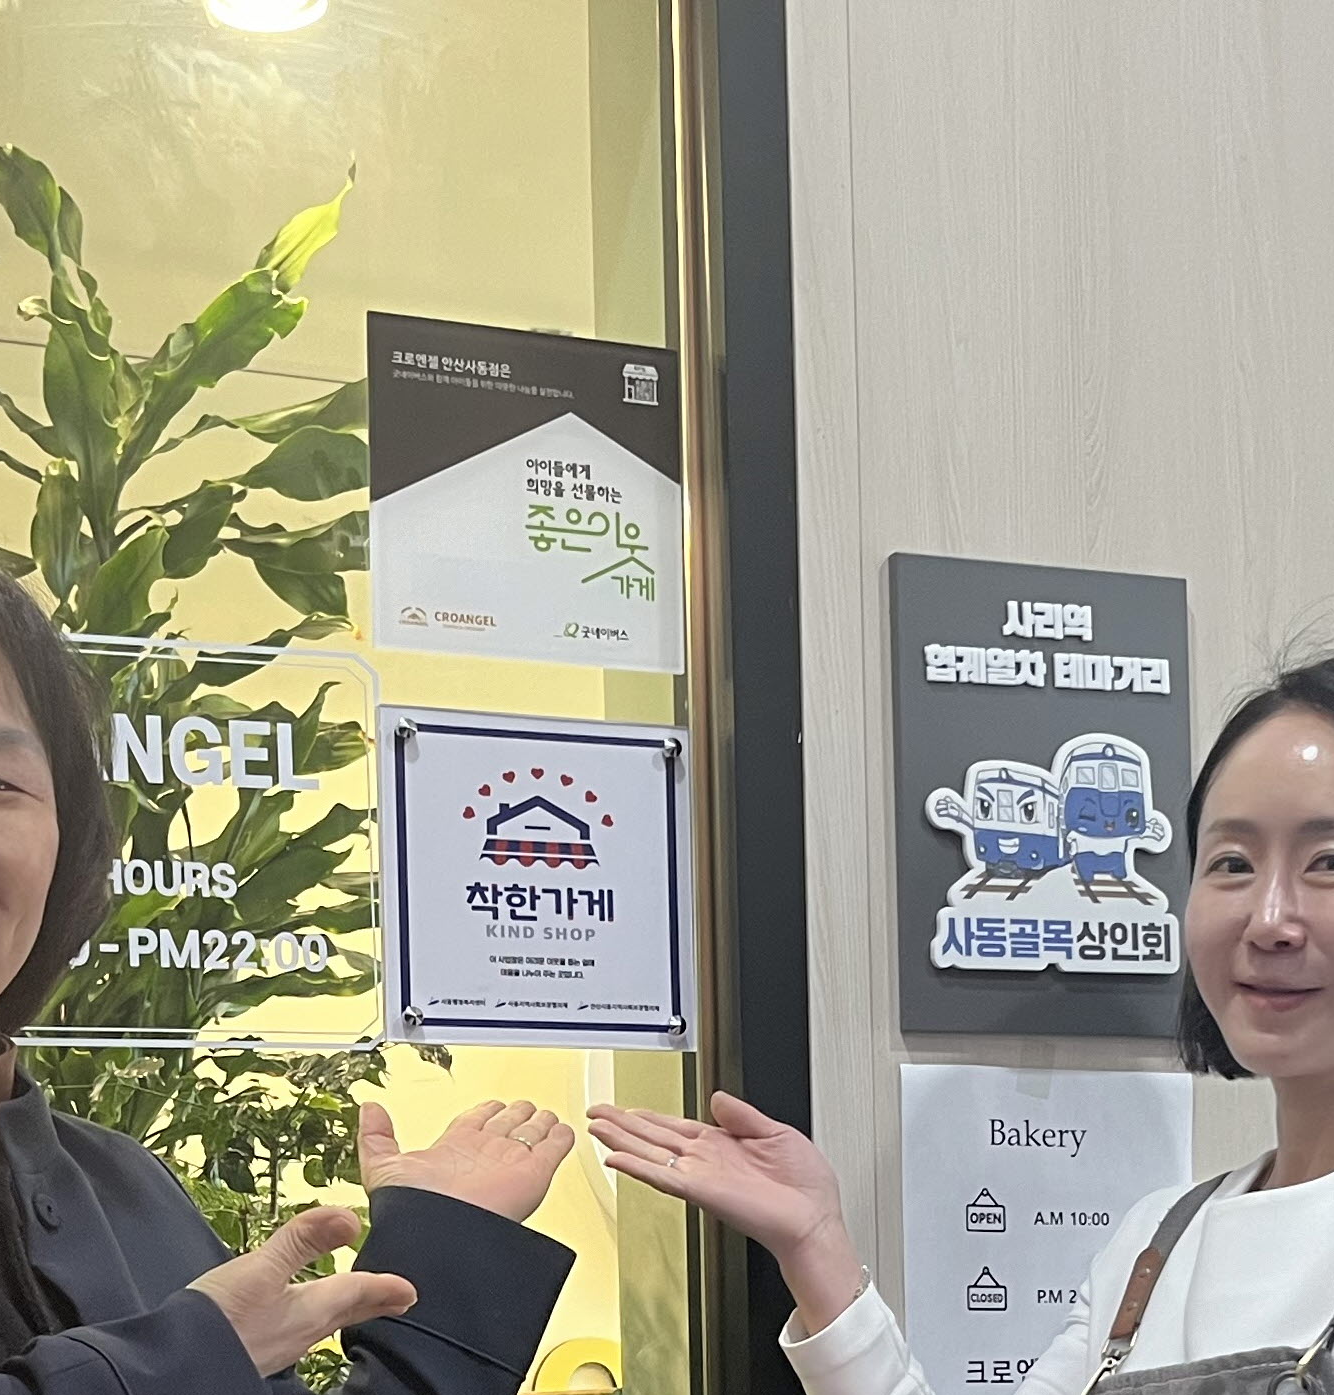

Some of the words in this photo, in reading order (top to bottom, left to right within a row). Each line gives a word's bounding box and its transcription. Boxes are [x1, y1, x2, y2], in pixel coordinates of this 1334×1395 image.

[392, 351, 439, 370] 크로엔젤
[441, 357, 511, 378] 안산사동점은
[526, 458, 591, 480] 아이들에게
[526, 478, 565, 498] 희망을
[571, 483, 622, 504] 선물하는
[611, 575, 655, 602] 가게
[434, 611, 497, 627] CROANGEL
[1002, 600, 1093, 641] 사리역
[581, 626, 629, 641] 굿네이버스
[1053, 652, 1170, 694] 테마거리
[102, 712, 320, 790] NGEL
[465, 882, 615, 922] 착한가게
[486, 924, 535, 939] KIND
[543, 927, 595, 942] SHOP
[989, 1119, 1087, 1158] Bakery
[970, 1212, 1002, 1224] OPEN
[1034, 1212, 1064, 1225] A.M
[1071, 1212, 1110, 1226] 10:00
[971, 1293, 1003, 1303] CLOSED
[1037, 1289, 1063, 1304] P.M
[1069, 1289, 1077, 1304] 2
